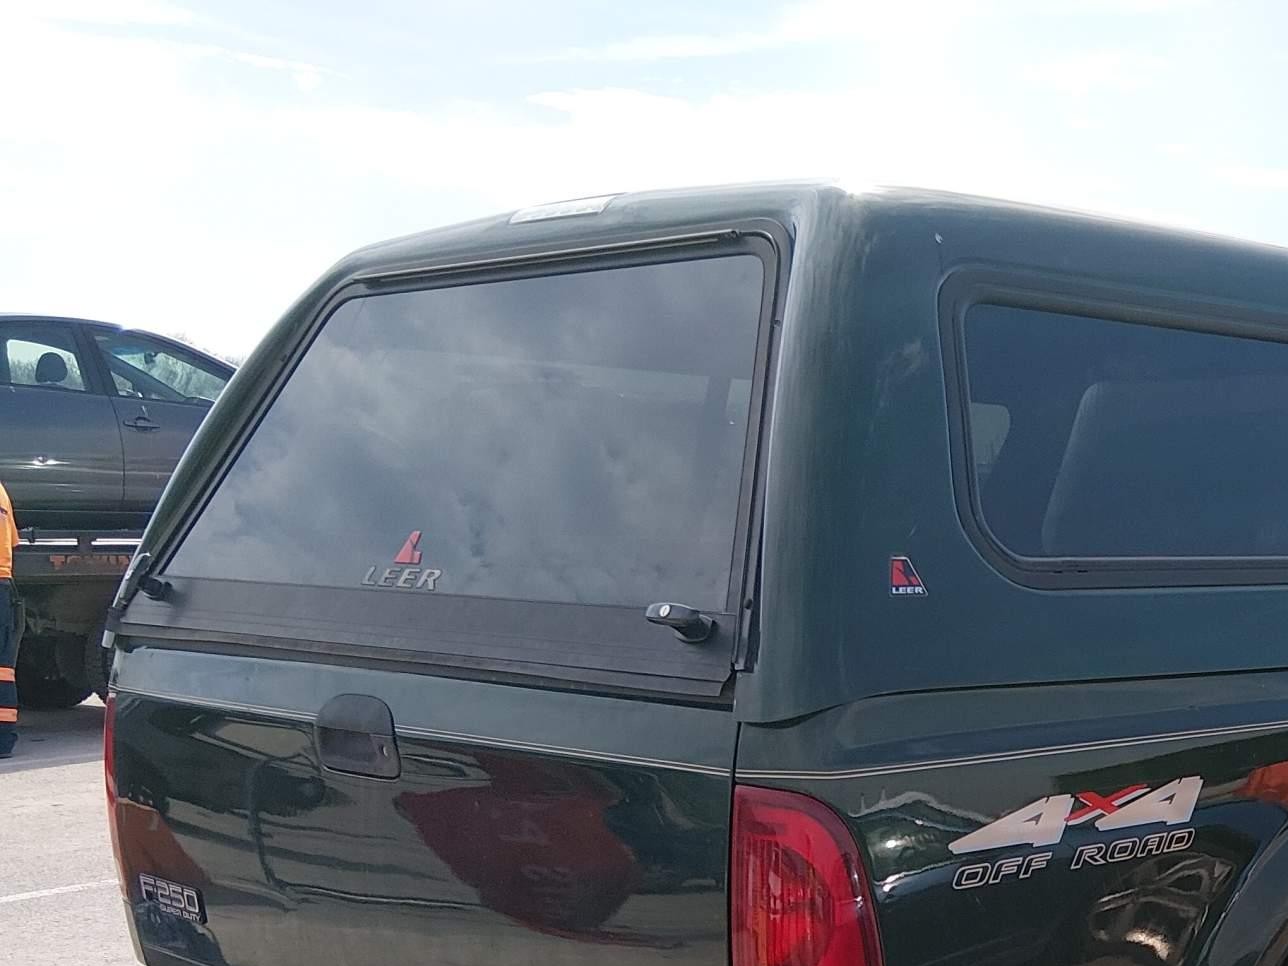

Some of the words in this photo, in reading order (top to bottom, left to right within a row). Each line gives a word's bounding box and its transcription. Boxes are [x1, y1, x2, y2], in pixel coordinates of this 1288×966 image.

[360, 565, 443, 592] LEER
[892, 586, 924, 594] LEER
[952, 851, 1053, 890] OFF
[1070, 827, 1196, 870] ROAD
[182, 909, 201, 921] DUTY
